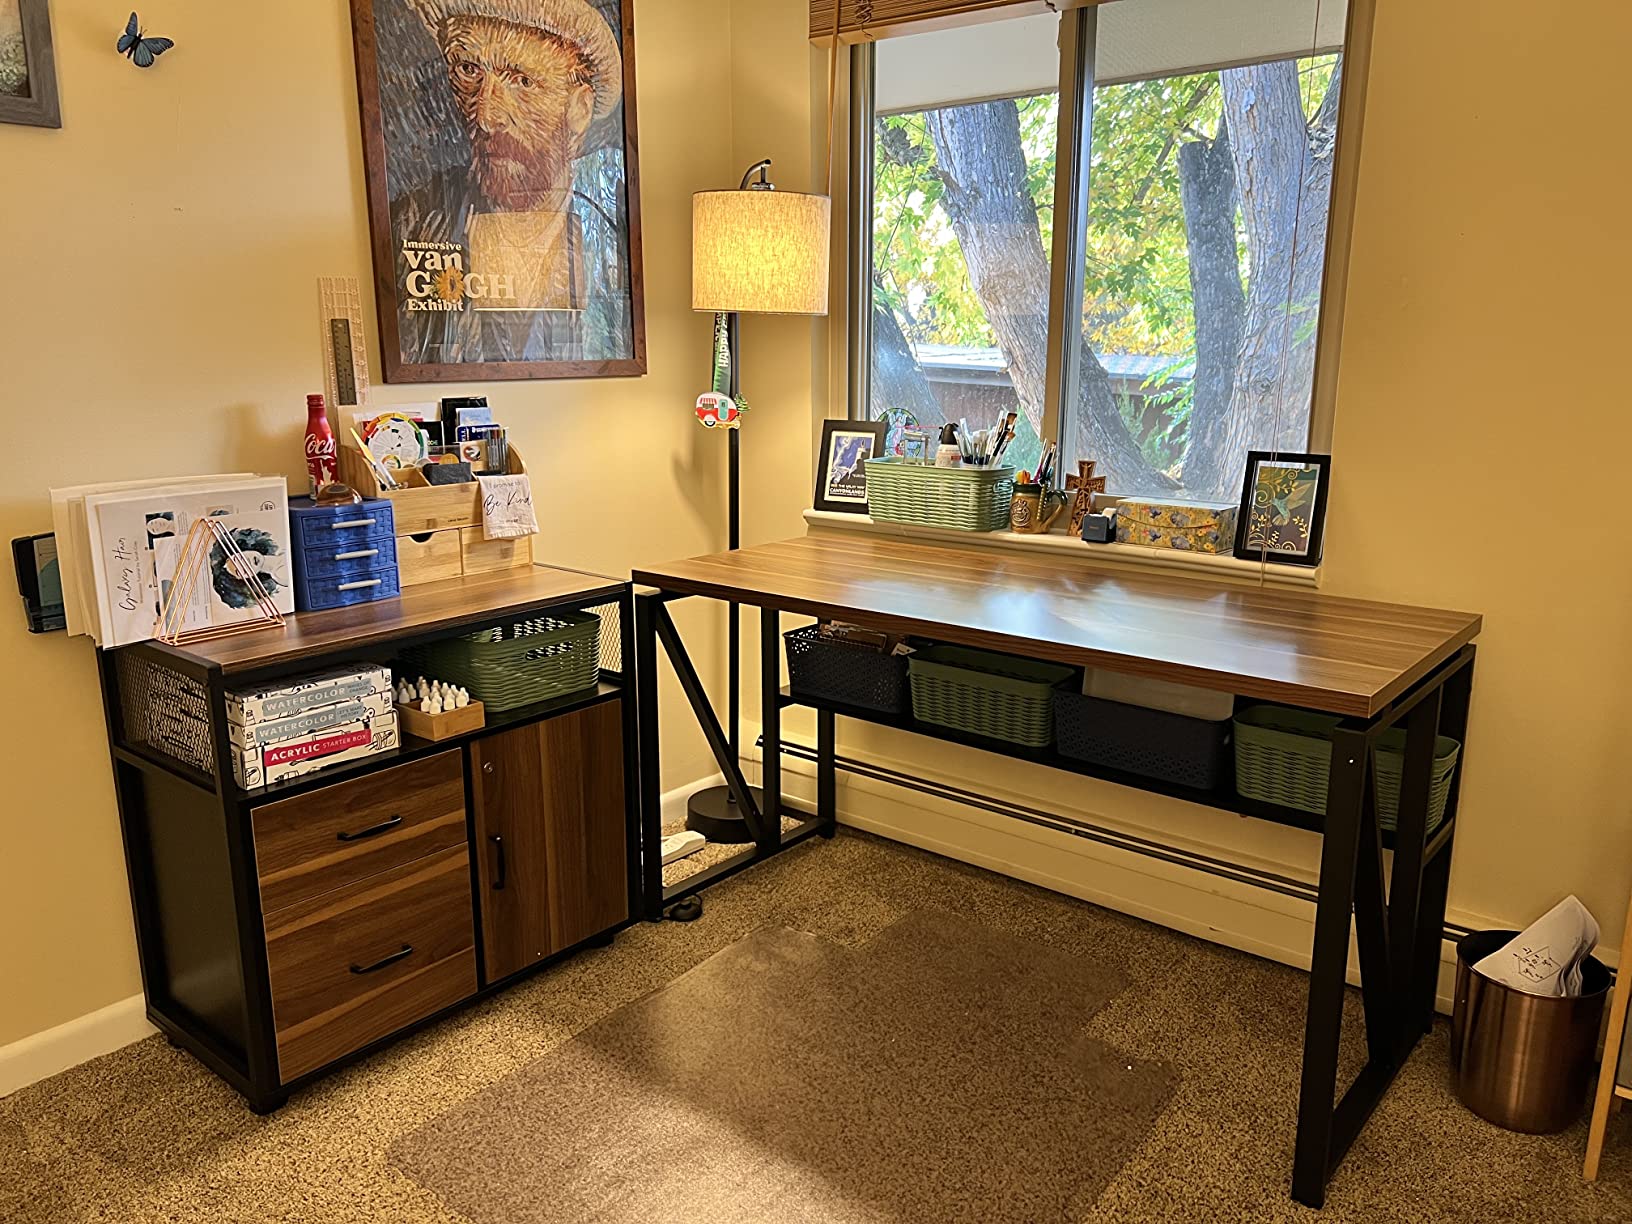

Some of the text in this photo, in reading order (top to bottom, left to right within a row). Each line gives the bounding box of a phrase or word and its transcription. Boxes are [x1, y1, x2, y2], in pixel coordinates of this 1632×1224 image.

[403, 239, 462, 250] Immersive
[402, 250, 463, 271] van
[407, 298, 464, 312] Exhibit
[484, 491, 532, 516] Be Kind
[117, 568, 137, 611] Galaxy
[266, 687, 345, 712] WATERCOLOR
[259, 713, 335, 738] WATERCOLOR
[271, 734, 366, 761] ACRYLIC STARTER BOX
